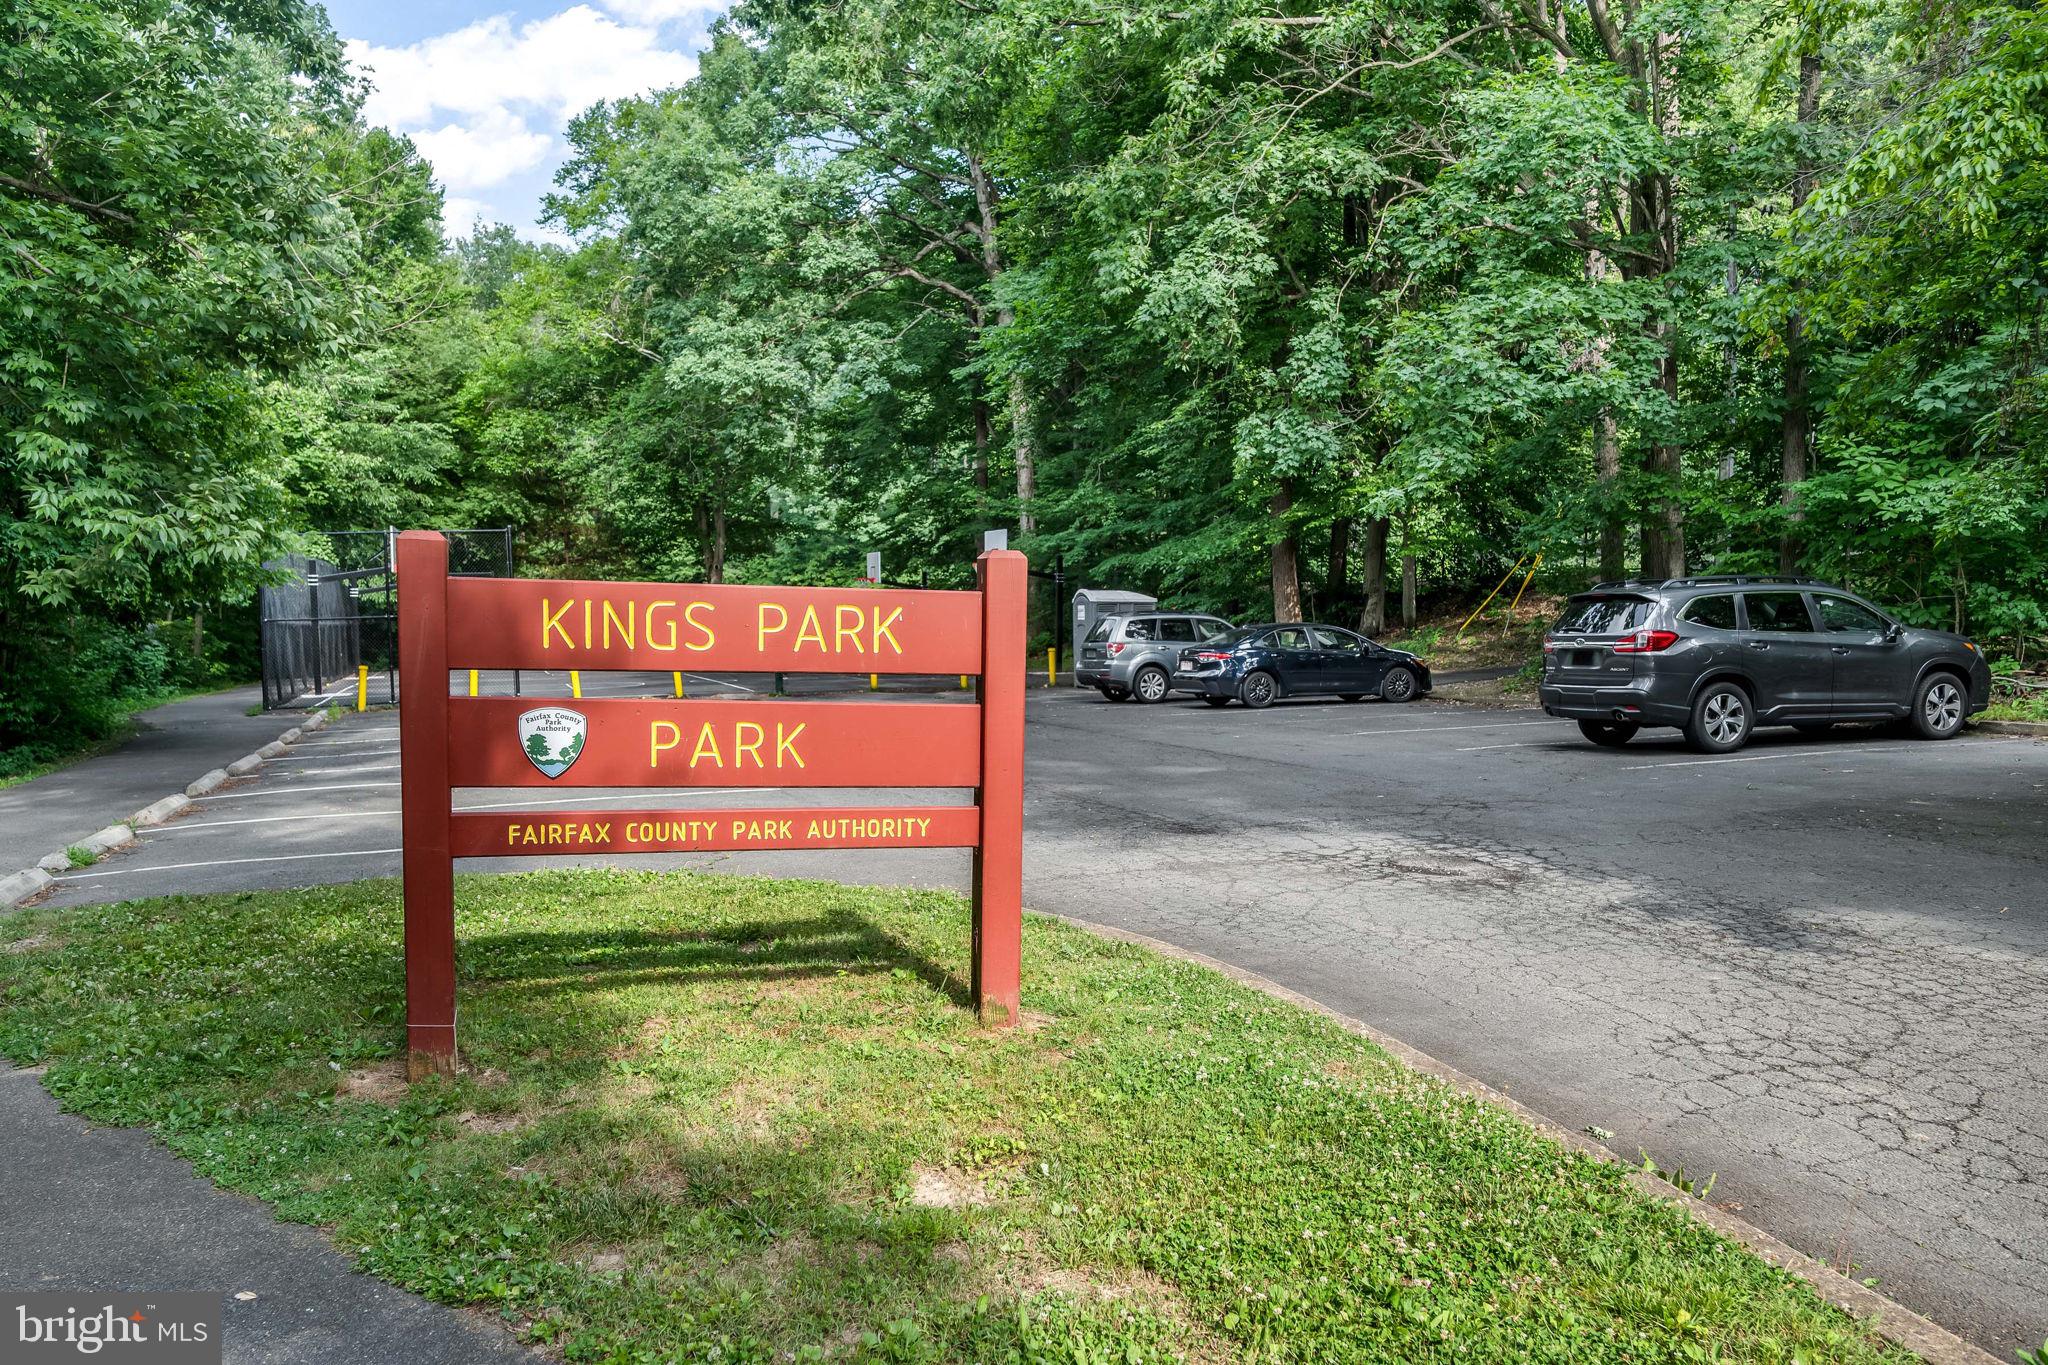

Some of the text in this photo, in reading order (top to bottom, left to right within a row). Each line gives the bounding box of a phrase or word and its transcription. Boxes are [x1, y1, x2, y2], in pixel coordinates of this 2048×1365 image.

[541, 598, 905, 654] KINGS PARK
[525, 712, 582, 725] Fairfax County
[649, 720, 807, 769] PARK
[507, 816, 931, 846] FAIRFAX COUNTY PARK AUTHORITY
